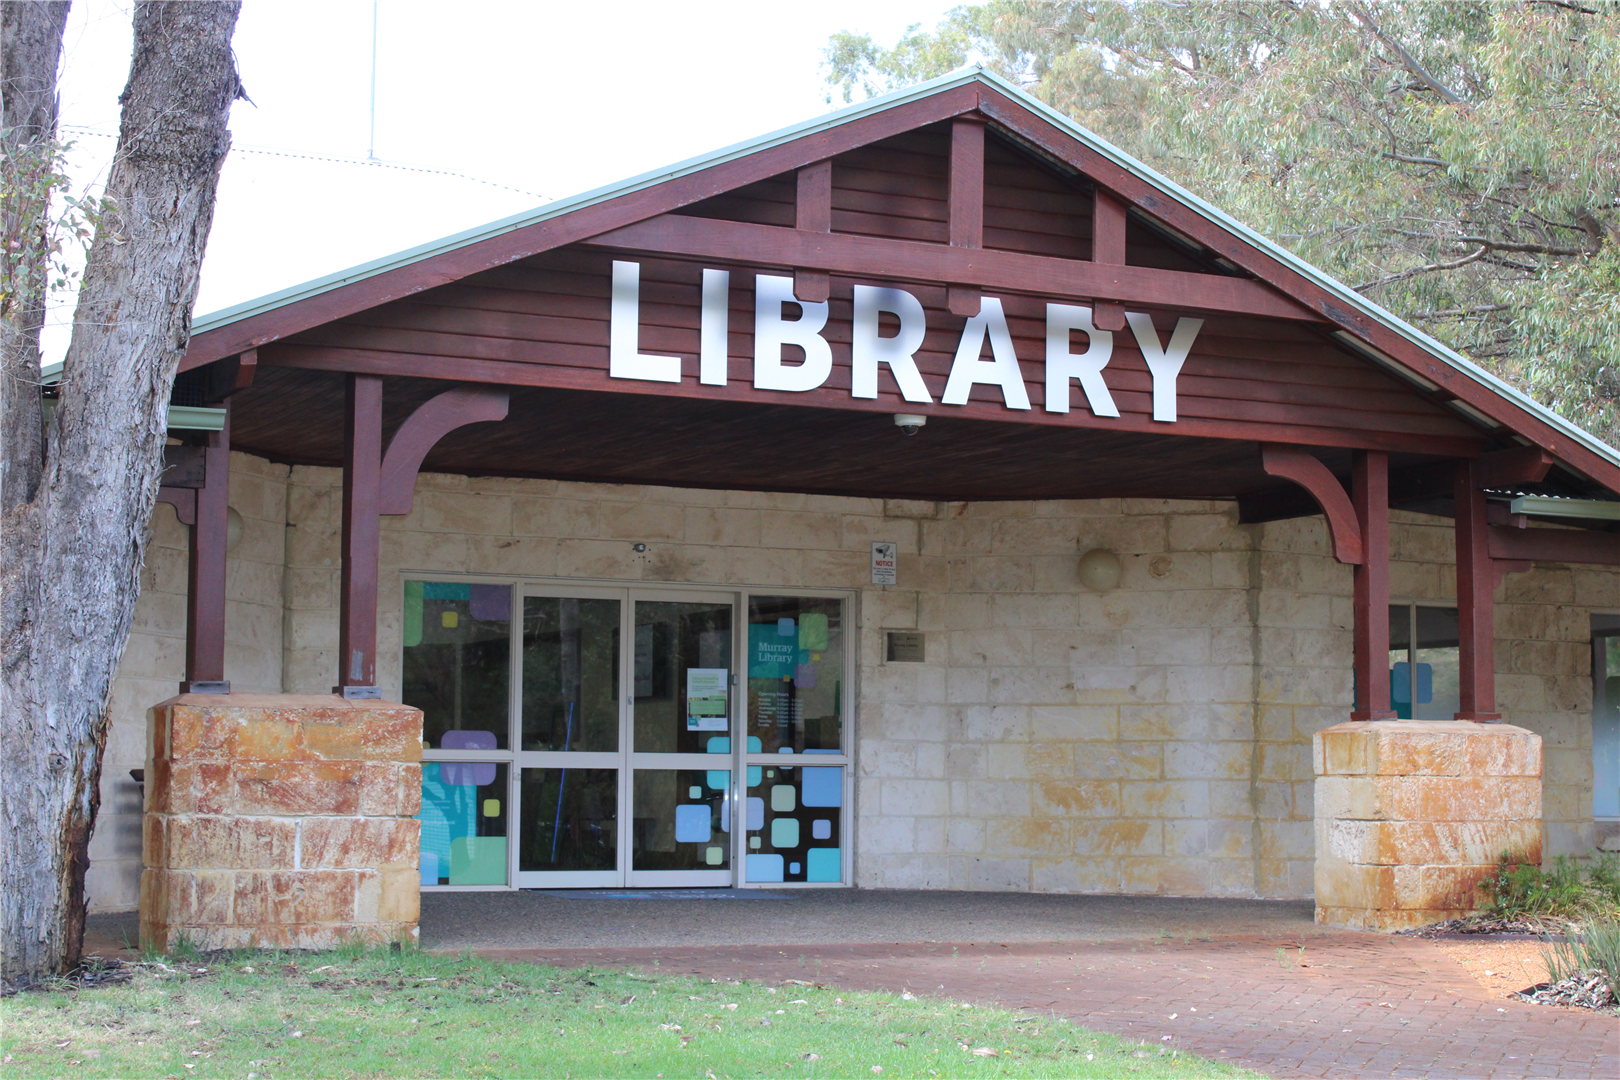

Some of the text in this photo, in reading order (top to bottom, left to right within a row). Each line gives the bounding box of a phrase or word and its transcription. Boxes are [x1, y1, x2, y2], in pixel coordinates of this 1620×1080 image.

[609, 260, 1205, 423] LIBRARY
[758, 642, 793, 654] Murray
[758, 652, 793, 664] Library
